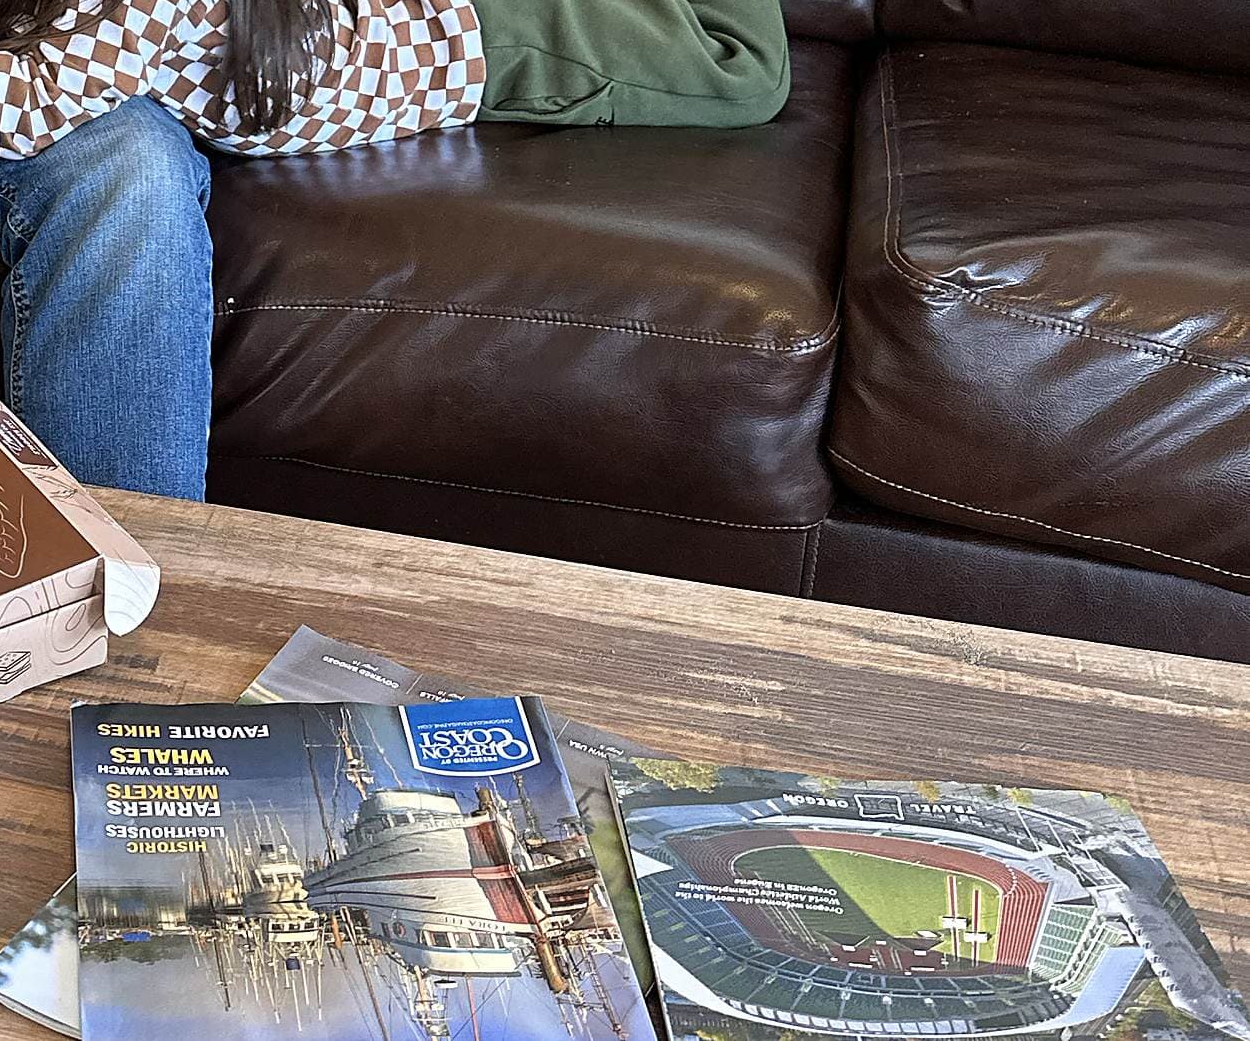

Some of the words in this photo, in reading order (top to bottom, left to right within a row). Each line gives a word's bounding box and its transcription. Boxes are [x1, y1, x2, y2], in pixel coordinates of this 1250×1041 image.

[97, 723, 161, 738] HIKES
[168, 724, 270, 739] FAVORITE
[418, 727, 513, 747] COAST
[421, 738, 528, 760] OREGON
[109, 746, 214, 765] WHALES
[441, 757, 452, 765] BY
[453, 756, 498, 764] PRESENTED
[97, 764, 150, 776] WATCH
[153, 766, 172, 776] TO
[174, 766, 230, 776] WHERE
[105, 783, 218, 800] MARKETS
[782, 793, 849, 808] OREGON
[106, 799, 221, 817] FARMERS
[910, 803, 977, 814] TRAVEL
[105, 824, 225, 838] LIGHTHOUSES
[126, 840, 207, 854] HISTORIC
[678, 882, 760, 896] Championships
[734, 878, 773, 889] Eugene
[774, 882, 785, 890] in
[693, 892, 705, 900] to
[706, 892, 735, 903] world
[736, 896, 753, 905] the
[760, 890, 807, 902] Athletics
[808, 896, 841, 906] World
[754, 898, 804, 910] welcomes
[805, 903, 844, 915] Oregon
